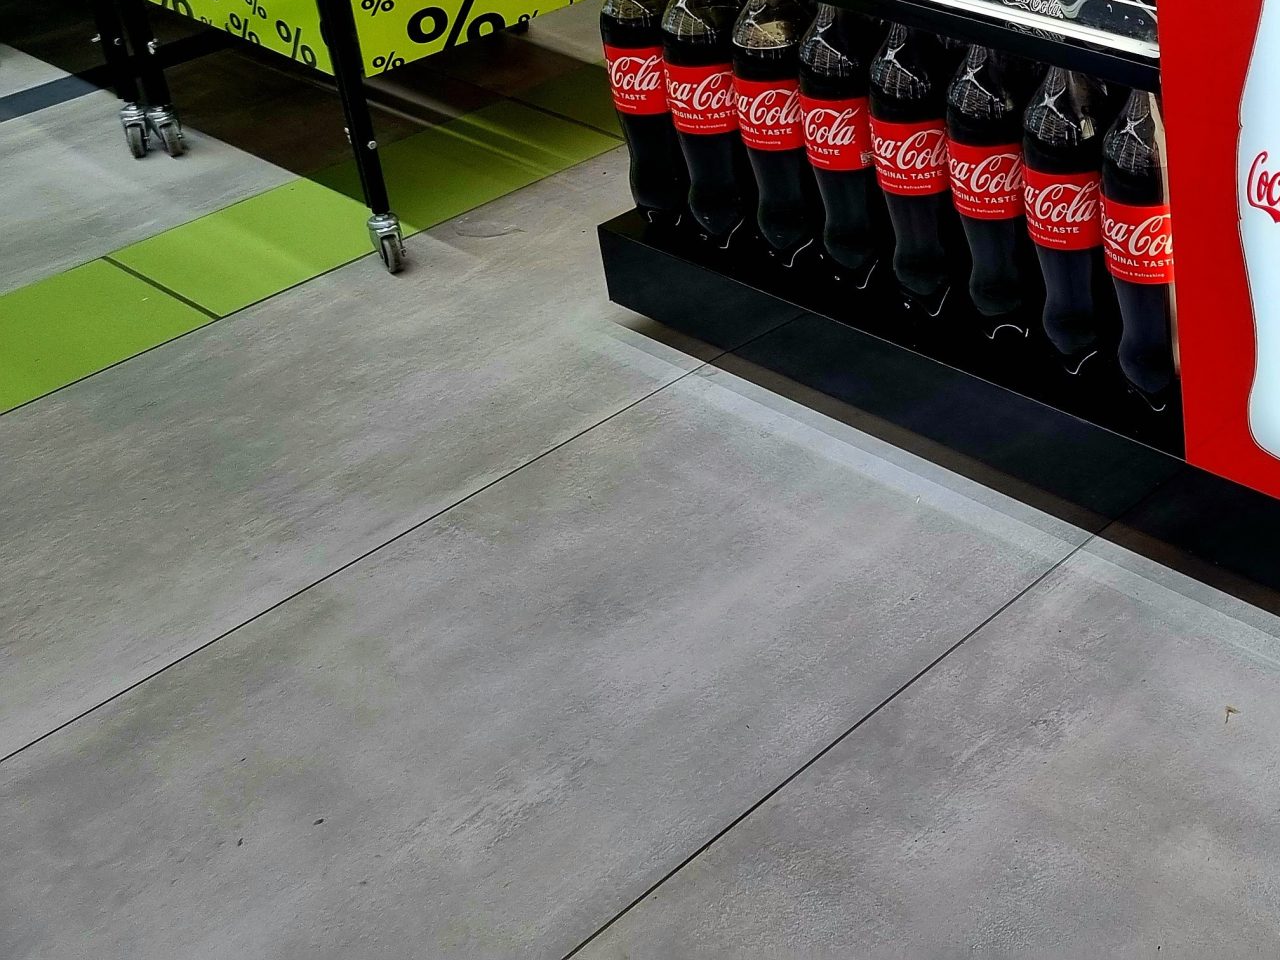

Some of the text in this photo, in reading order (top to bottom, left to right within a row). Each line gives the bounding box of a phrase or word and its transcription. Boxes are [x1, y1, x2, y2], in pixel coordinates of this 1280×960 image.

[761, 128, 793, 136] TASTE
[910, 169, 943, 181] TASTE
[984, 194, 1017, 205] TASTE
[1046, 225, 1080, 235] TASTE
[1143, 259, 1175, 269] TAST
